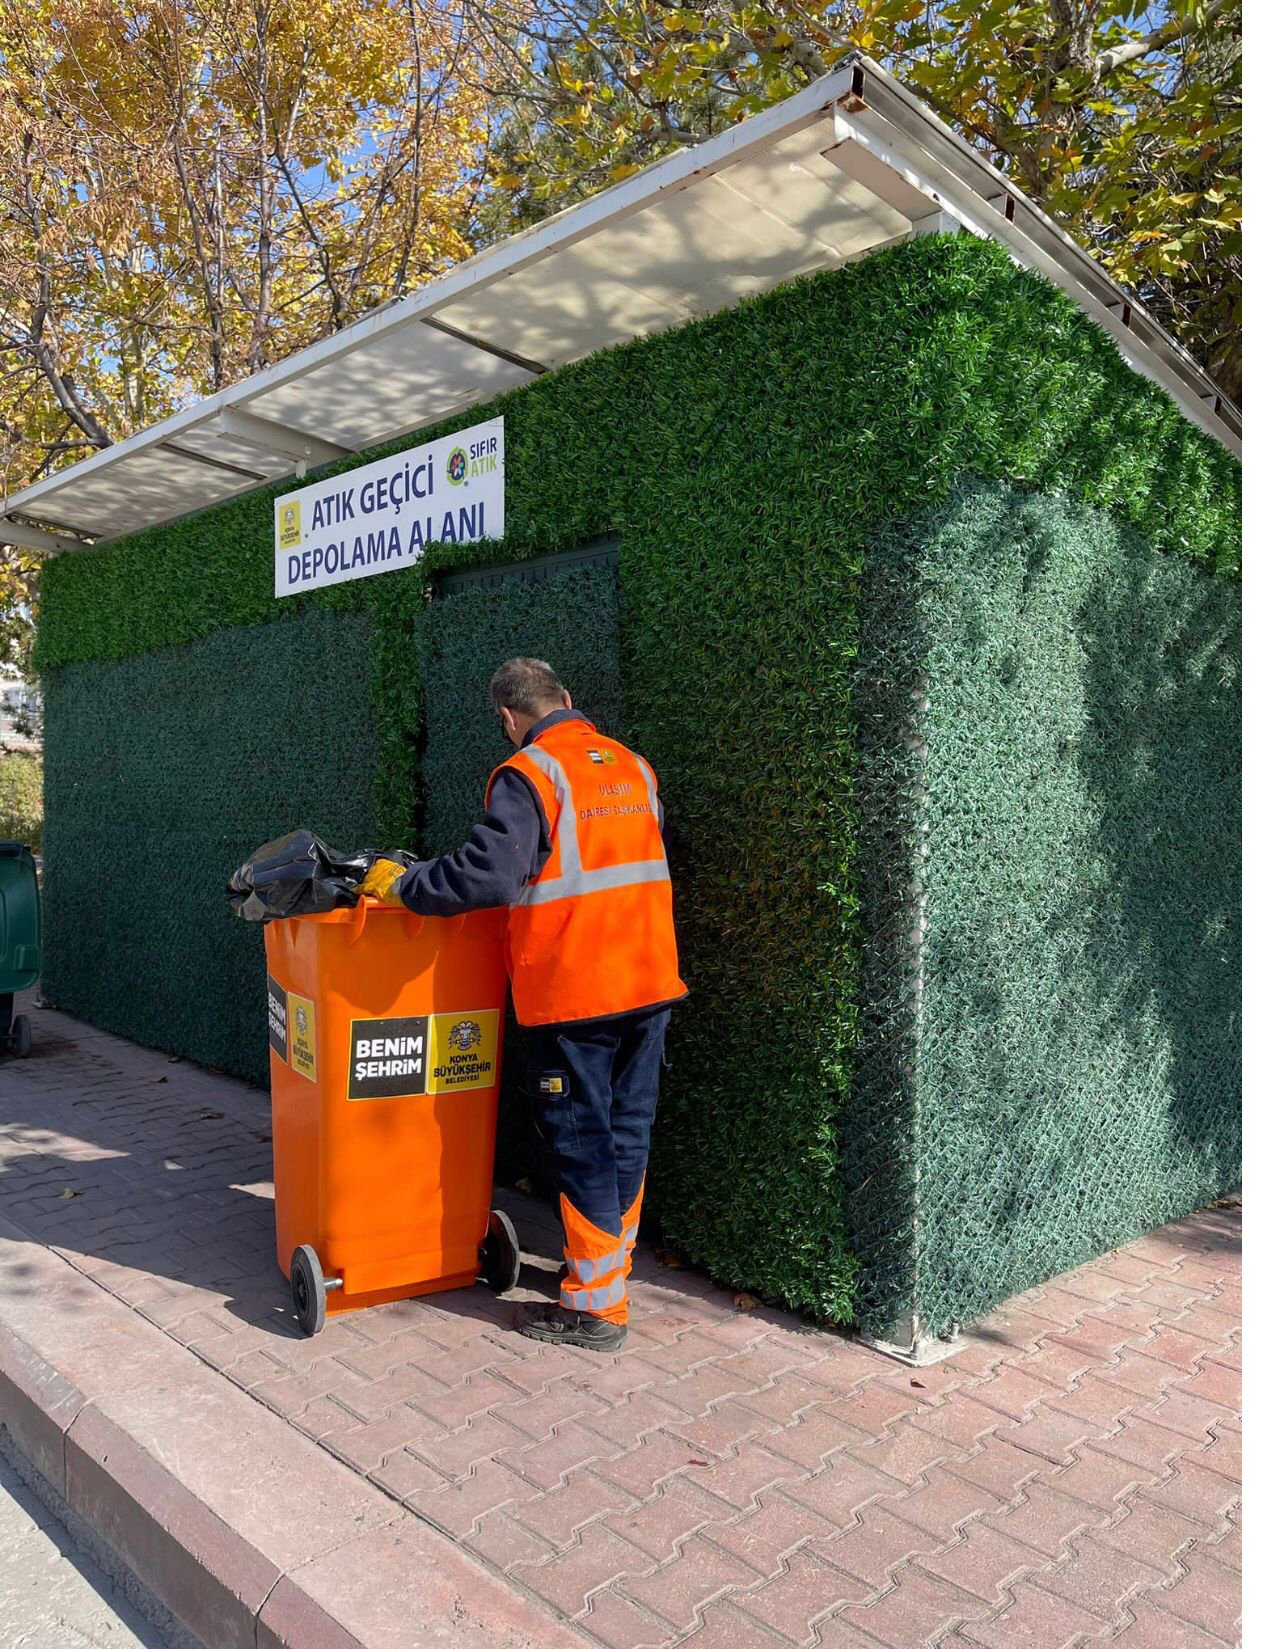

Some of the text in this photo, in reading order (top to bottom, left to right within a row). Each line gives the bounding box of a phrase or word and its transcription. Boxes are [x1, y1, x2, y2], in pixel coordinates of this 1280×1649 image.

[470, 437, 497, 460] SIFIR
[471, 454, 497, 477] ATIK
[312, 454, 434, 531] ATIK GEÇİCİ
[288, 526, 402, 584] DEPOLAMA
[356, 1036, 423, 1058] BENİM
[449, 1053, 478, 1063] KONYA
[355, 1058, 422, 1081] ŞEHRİM
[433, 1061, 491, 1079] BÜYÜKŞEHİR
[445, 1075, 480, 1085] BELEDİYESİ
